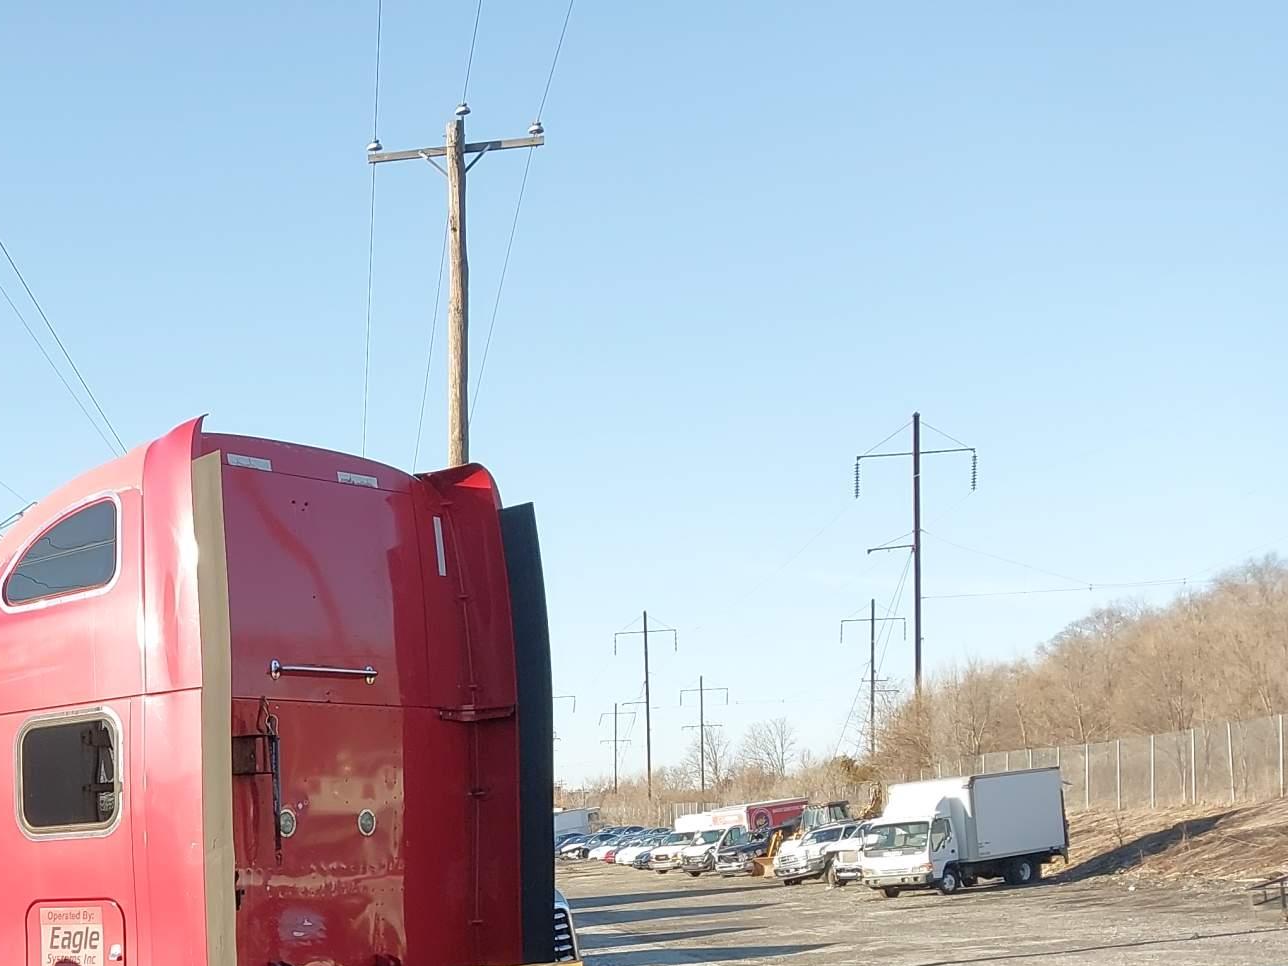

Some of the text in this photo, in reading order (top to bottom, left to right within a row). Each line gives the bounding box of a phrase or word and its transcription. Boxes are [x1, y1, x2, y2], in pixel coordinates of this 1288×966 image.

[47, 910, 95, 921] Operated By:
[49, 926, 100, 954] Eagle
[83, 953, 97, 965] Inc
